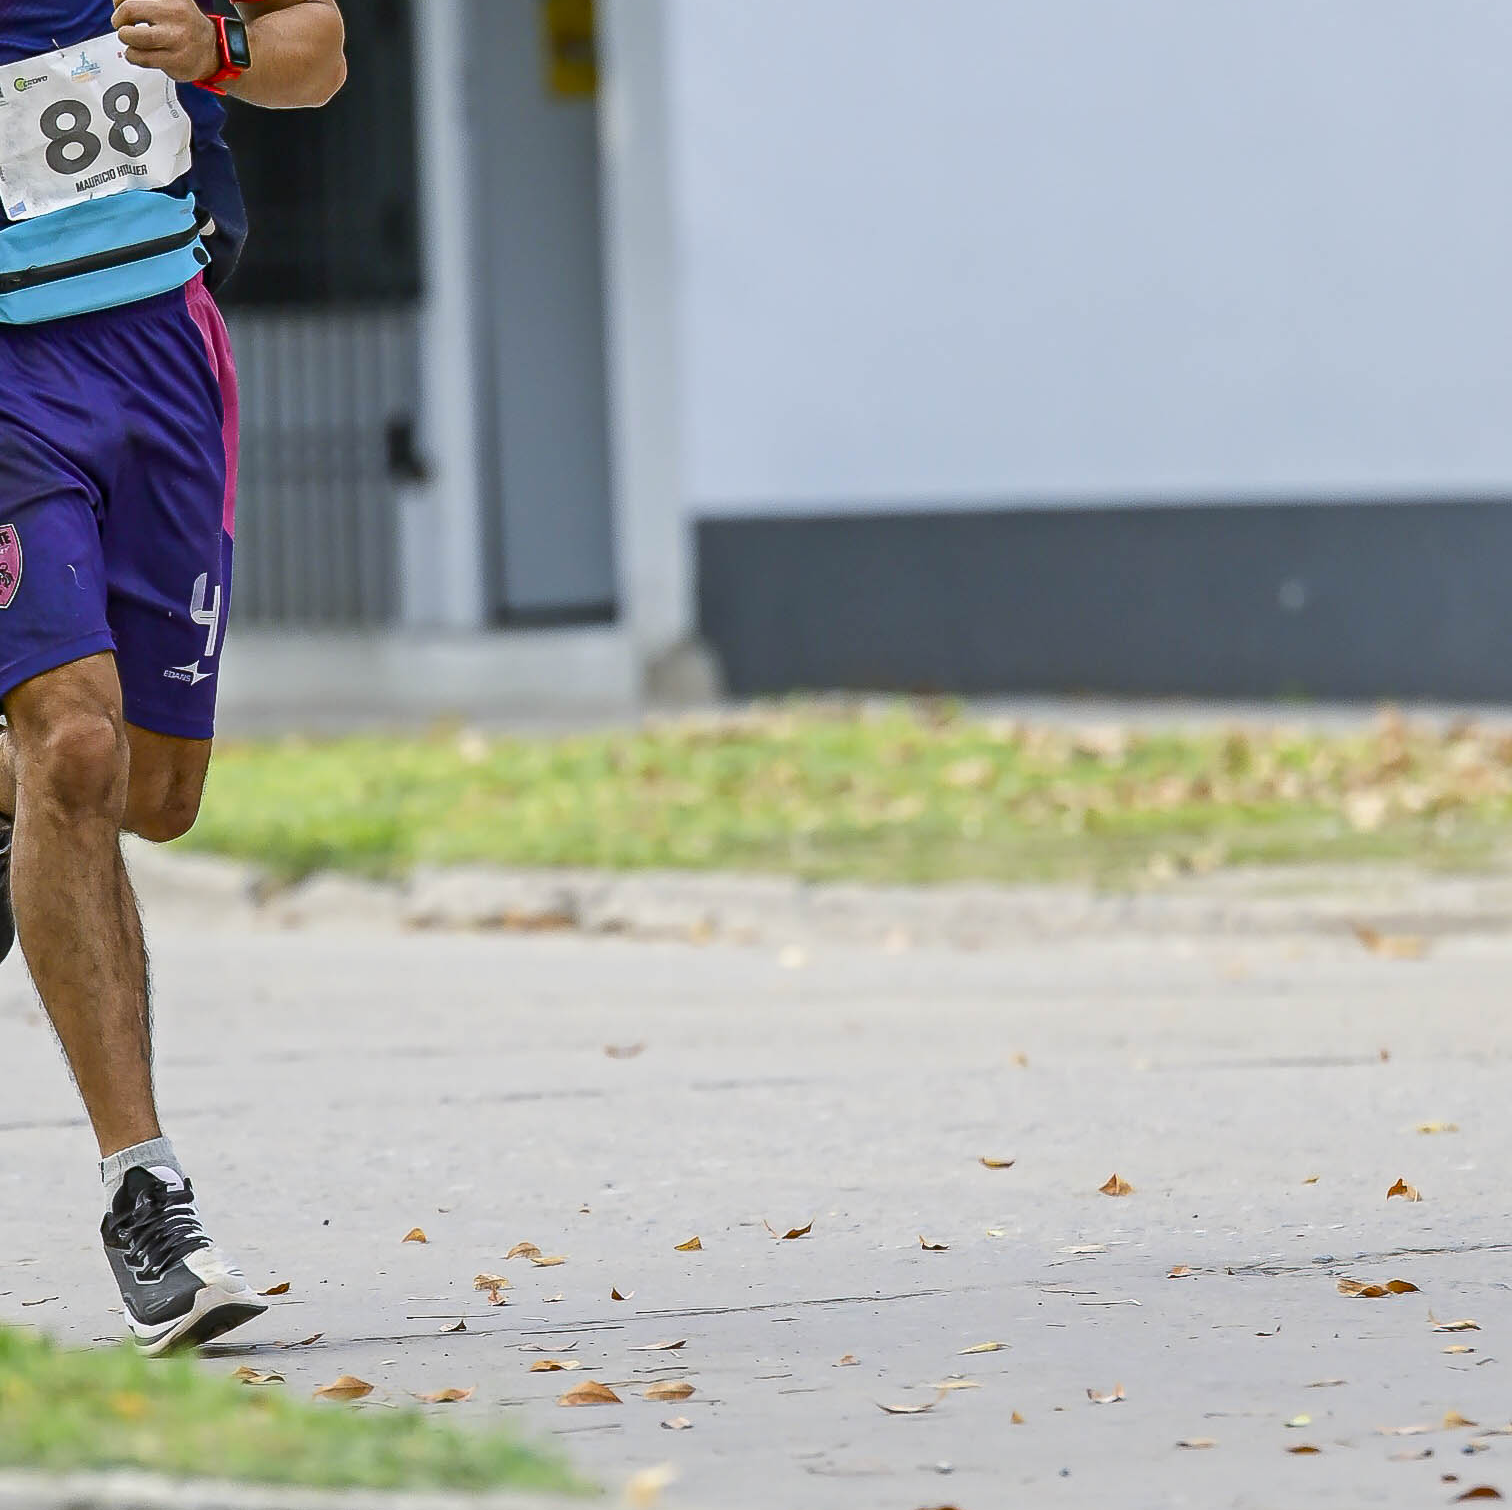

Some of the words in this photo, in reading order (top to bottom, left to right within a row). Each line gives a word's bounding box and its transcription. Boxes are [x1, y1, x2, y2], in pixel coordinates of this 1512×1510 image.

[39, 81, 152, 176] 88
[75, 168, 117, 193] MAURICIO
[190, 572, 221, 657] 4
